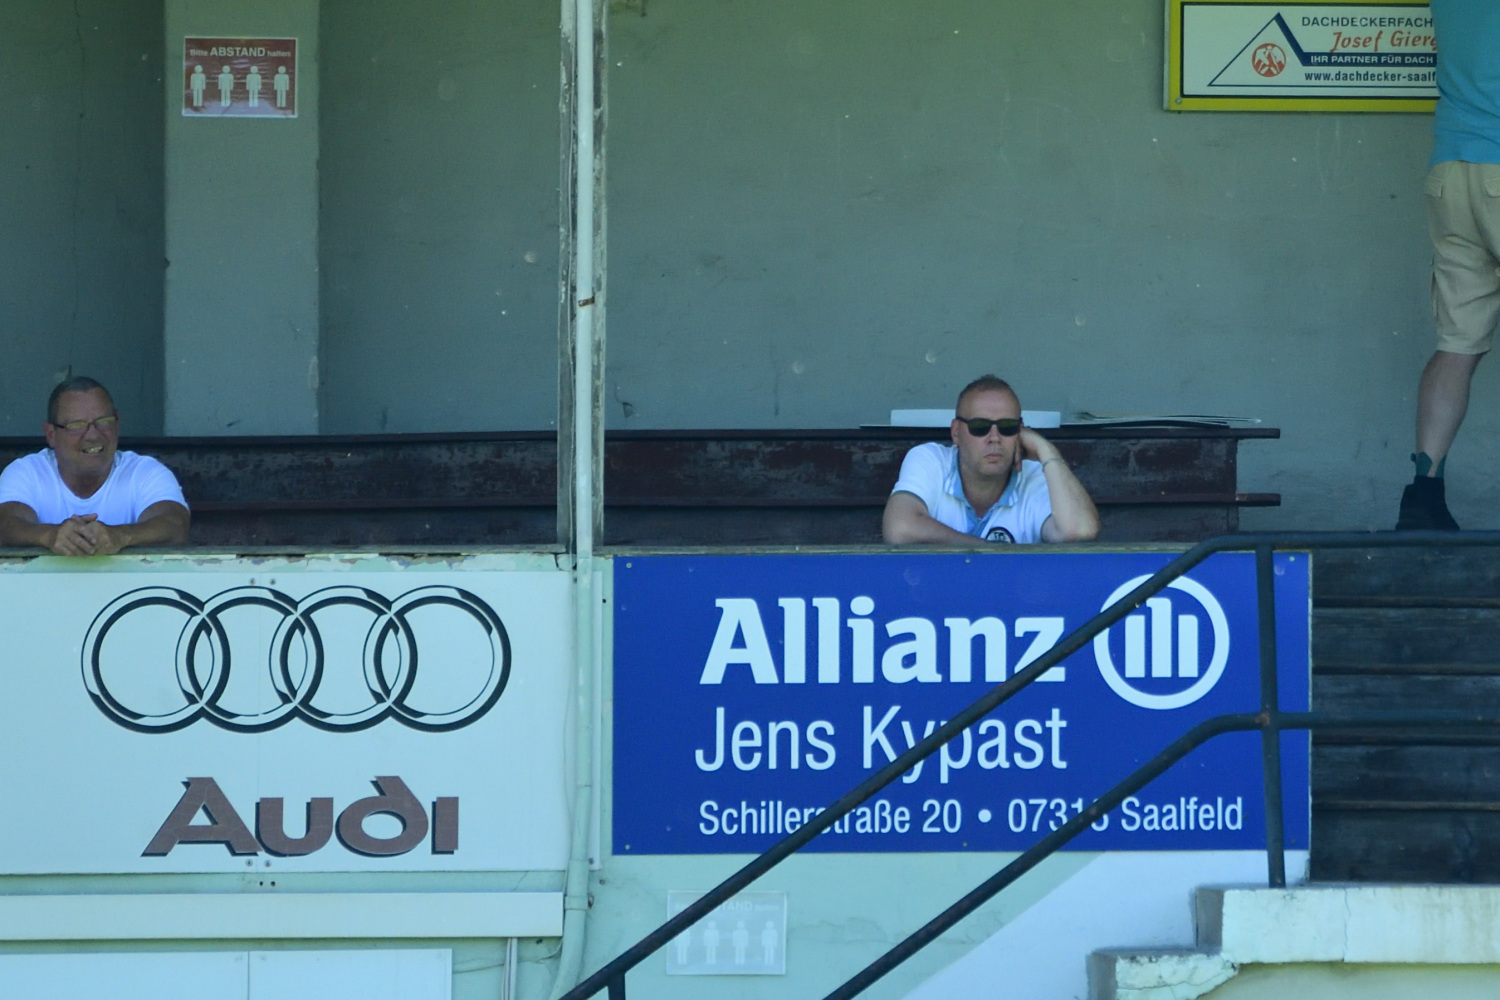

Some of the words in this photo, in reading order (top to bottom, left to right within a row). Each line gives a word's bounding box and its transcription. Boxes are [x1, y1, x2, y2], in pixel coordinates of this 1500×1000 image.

[190, 48, 208, 57] Bitte
[210, 46, 266, 57] ABSTAND
[267, 49, 291, 57] halten
[1310, 55, 1329, 64] IHR
[1331, 55, 1378, 64] PARTNER
[1381, 54, 1402, 64] FÜR
[1404, 56, 1434, 64] DACH
[1330, 30, 1384, 53] Josef
[699, 595, 1067, 685] Allianz
[694, 706, 837, 772] Jens
[862, 705, 1068, 784] Kypast
[140, 775, 460, 858] Audi
[921, 798, 962, 834] 20
[1121, 796, 1243, 832] Saalfeld
